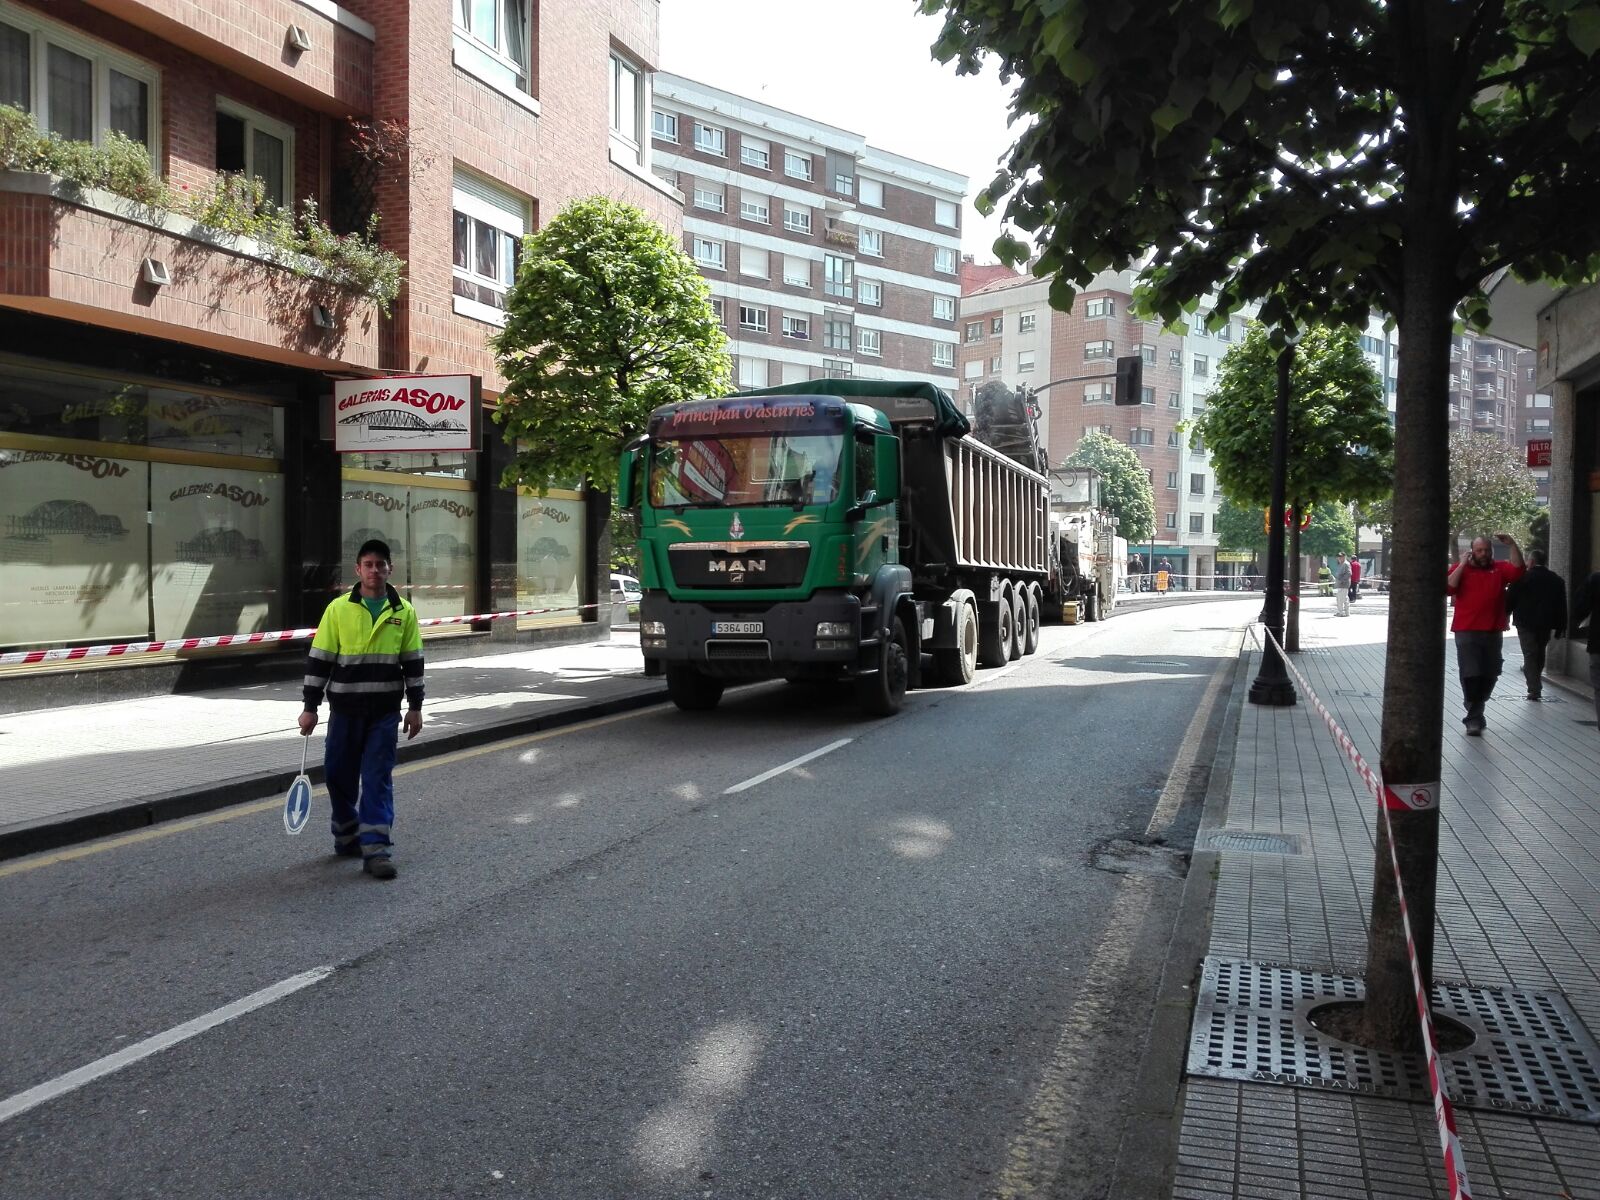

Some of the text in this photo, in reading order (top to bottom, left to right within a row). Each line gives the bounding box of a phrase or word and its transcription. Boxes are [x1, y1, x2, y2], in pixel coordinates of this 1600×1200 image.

[338, 388, 466, 414] GALERIAS ASON
[673, 407, 740, 426] principau
[56, 453, 130, 479] ASON
[169, 482, 270, 508] GALERIAS ASON
[364, 490, 405, 512] ASON
[439, 499, 474, 518] ASON
[543, 507, 570, 523] ASON
[709, 560, 766, 572] MAN
[717, 623, 762, 633] 5364 GDD
